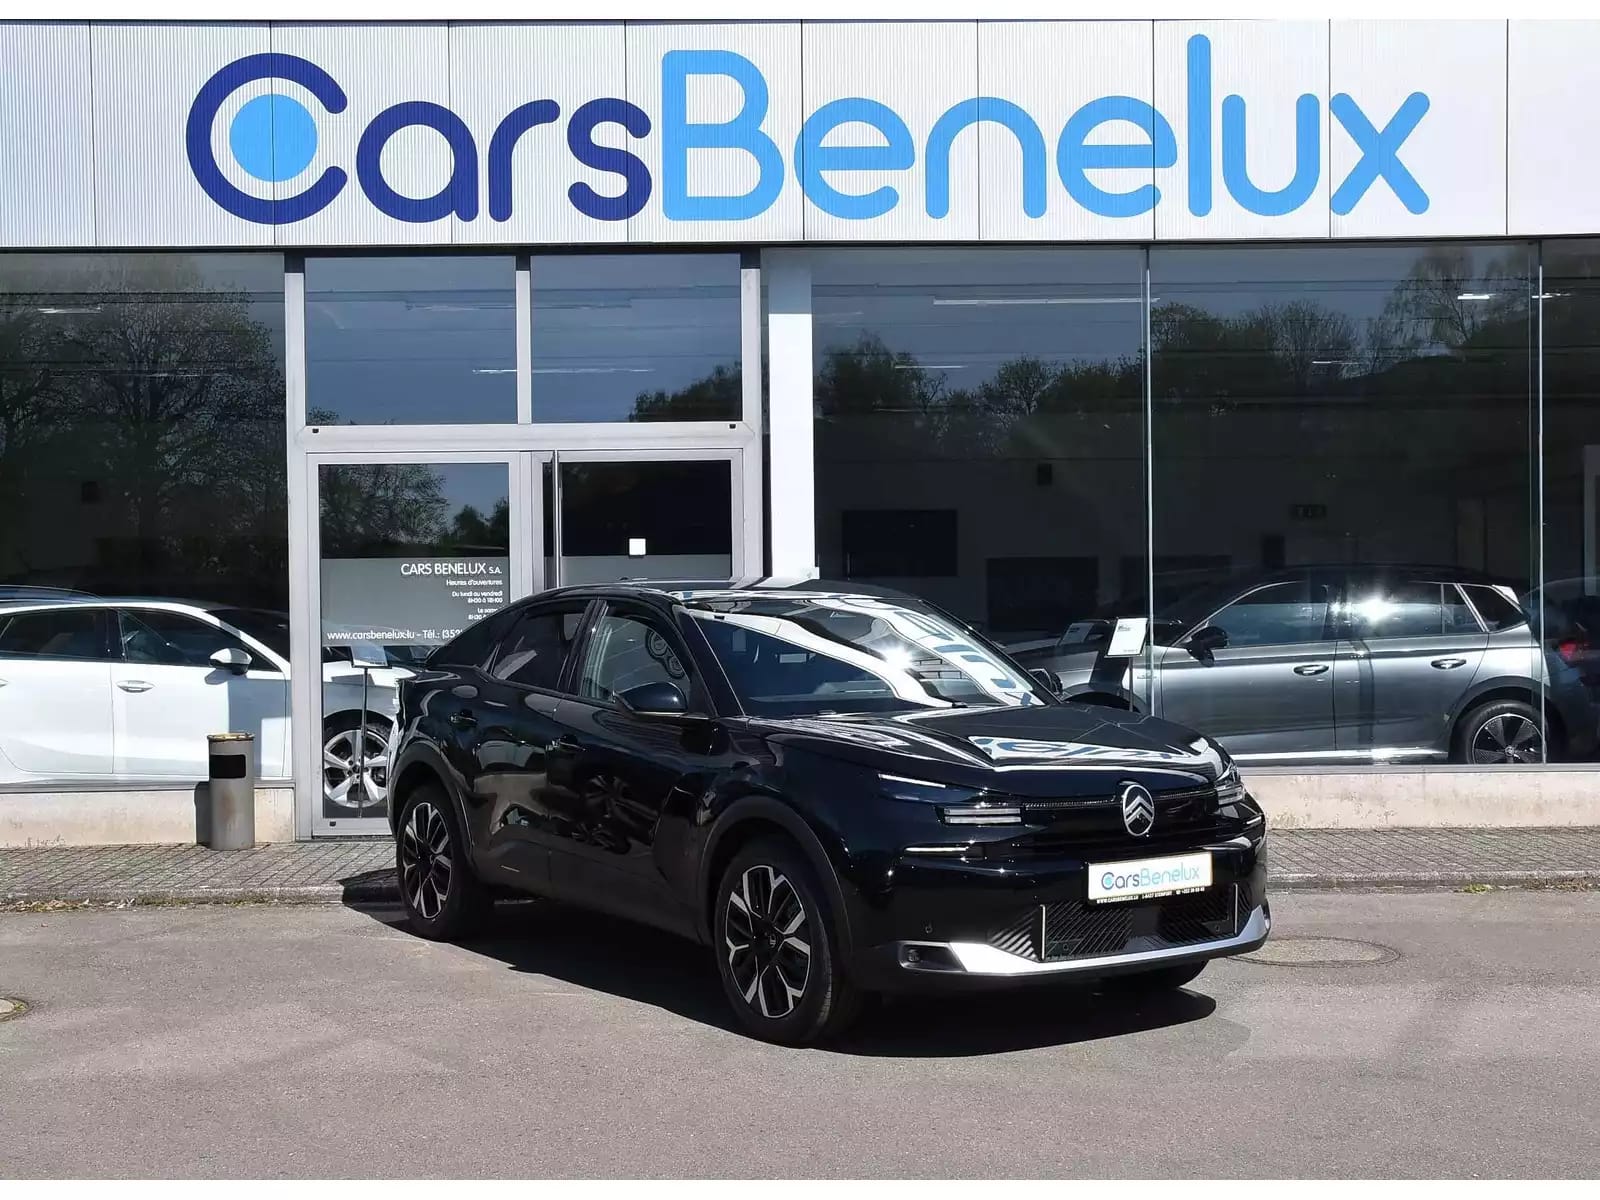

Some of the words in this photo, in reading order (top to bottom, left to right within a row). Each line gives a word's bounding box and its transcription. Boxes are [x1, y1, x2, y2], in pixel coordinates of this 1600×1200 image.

[187, 34, 1430, 223] CarsBenelux
[400, 563, 432, 575] CARS
[434, 563, 486, 575] BENELUX
[327, 630, 415, 640] www.carsbenelux.lu
[1101, 862, 1200, 890] CarsBenelux
